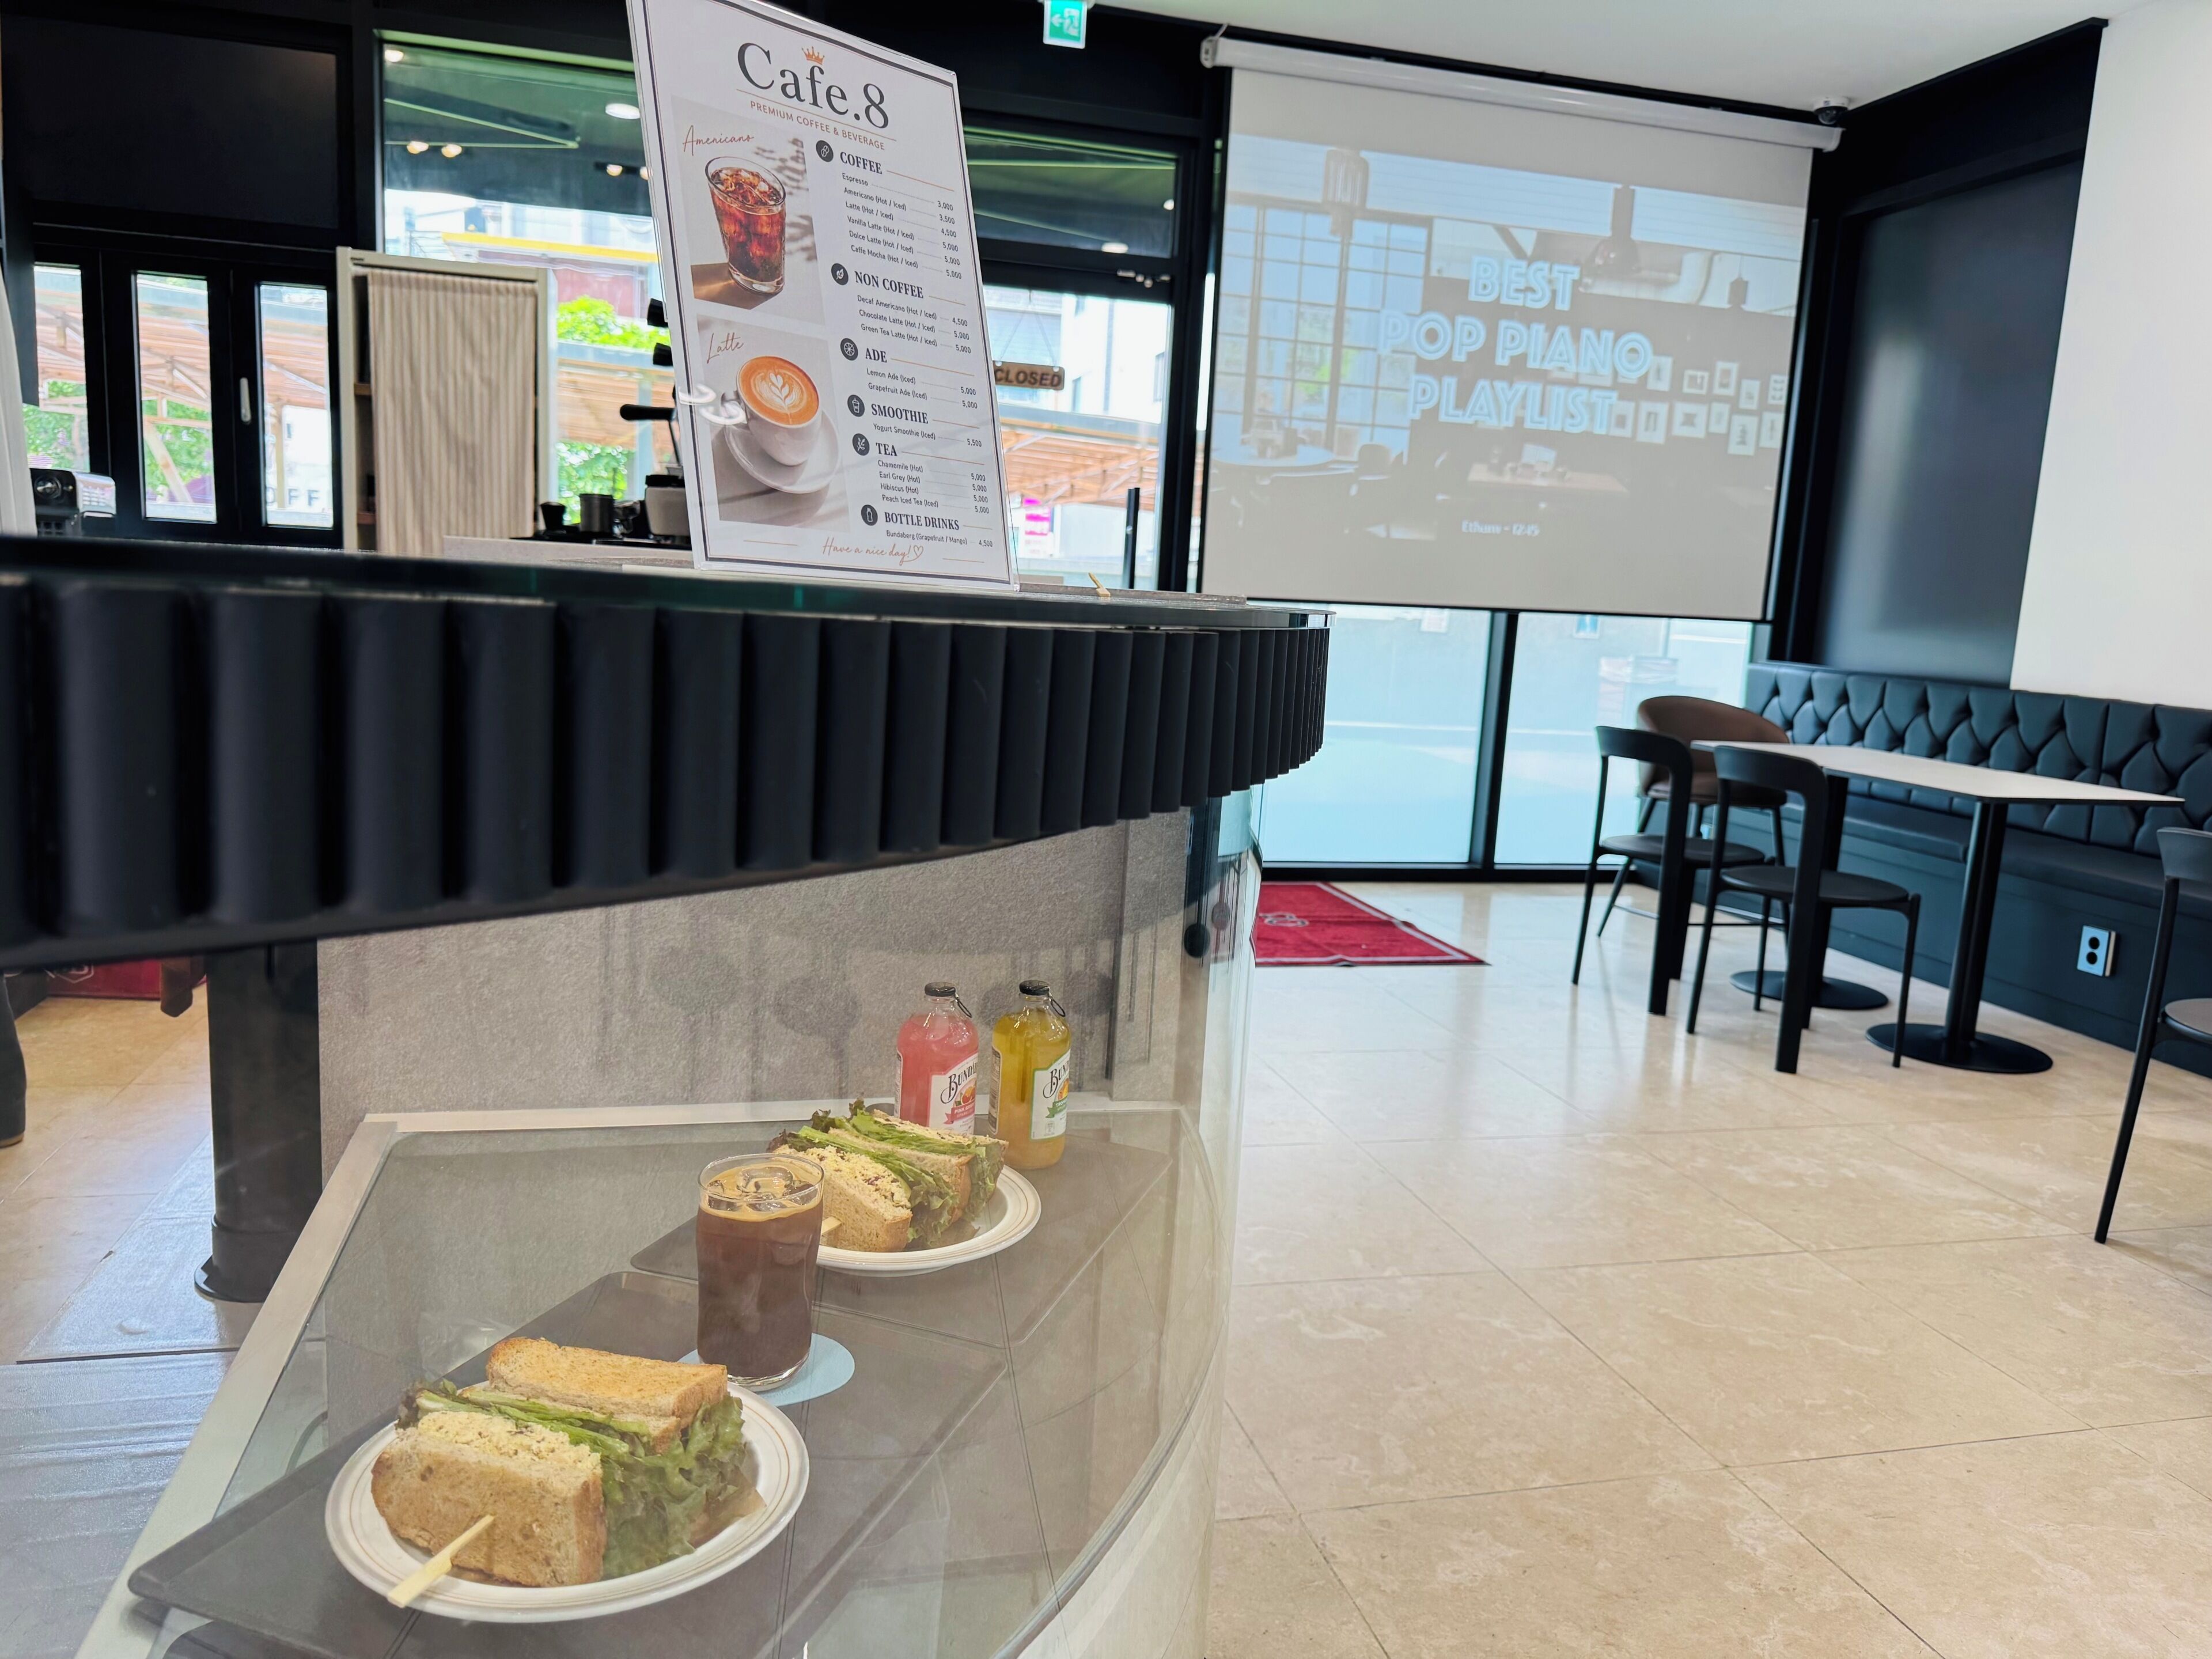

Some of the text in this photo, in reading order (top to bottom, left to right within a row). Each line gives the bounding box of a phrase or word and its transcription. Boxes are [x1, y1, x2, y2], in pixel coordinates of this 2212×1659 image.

[737, 43, 888, 129] Cafe.8
[750, 100, 885, 150] PREMIUM COFFEE & BEVERAGE
[682, 124, 755, 157] Americano
[840, 151, 882, 174] COFFEE
[842, 173, 869, 186] Espresso
[844, 187, 874, 201] Americano
[876, 196, 887, 205] (Hot
[893, 200, 907, 211] Iced)
[846, 200, 861, 211] Latte
[862, 205, 874, 215] (Hot
[880, 211, 894, 221] Iced)
[847, 215, 866, 227] Vanilla
[868, 221, 882, 231] Latte
[883, 225, 895, 235] (Hot
[901, 230, 914, 241] Iced)
[849, 230, 865, 241] Dolce
[866, 235, 881, 245] Latte
[882, 239, 895, 249] (Hot
[900, 244, 914, 254] Iced)
[851, 244, 866, 255] Caffe
[868, 249, 886, 260] Mocha
[887, 253, 899, 263] (Hot
[905, 259, 918, 268] Iced)
[854, 271, 924, 298] NON COFFEE
[1468, 255, 1581, 311] BEST
[857, 295, 874, 305] Decaf
[876, 299, 905, 312] Americano
[907, 305, 918, 316] (Hot
[924, 310, 937, 320] Iced)
[859, 309, 887, 321] Chocolate
[888, 316, 903, 325] Latte
[904, 319, 916, 328] (Hot
[922, 324, 935, 333] Iced)
[861, 323, 878, 334] Green
[879, 327, 889, 336] Tea
[891, 331, 906, 339] Latte
[907, 333, 919, 342] (Hot
[924, 337, 937, 347] Iced)
[1378, 309, 1653, 379] POP PIANO
[706, 332, 744, 364] Latte
[865, 347, 887, 363] ADE
[866, 368, 886, 378] Lemon
[887, 372, 899, 380] Ade
[900, 374, 916, 385] (Iced)
[994, 368, 1062, 387] CLOSED
[868, 382, 899, 394] Grapefruit
[900, 388, 911, 396] Ade
[912, 389, 927, 400] (Iced)
[871, 403, 929, 424] SMOOTHIE
[1408, 373, 1618, 435] PLAYLIST
[873, 423, 892, 433] Yogurt
[893, 426, 919, 437] Smoothie
[921, 430, 935, 440] (Iced)
[876, 442, 897, 456] TEA
[878, 460, 908, 470] Chamomile
[910, 464, 923, 473] (Hot)
[879, 471, 891, 479] Earl
[892, 472, 906, 482] Grey
[907, 475, 921, 484] (Hot)
[880, 483, 904, 492] Hibiscus
[906, 486, 919, 495] (Hot)
[881, 494, 899, 502] Peach
[900, 497, 912, 505] Iced
[912, 498, 923, 506] Tea
[924, 499, 938, 508] (Iced)
[885, 512, 960, 531] BOTTLE DRINKS
[823, 536, 853, 556] Have
[865, 546, 887, 555] nice
[886, 530, 915, 540] Bundaberg
[916, 532, 944, 543] (Grapefruit
[949, 537, 968, 545] Mango)
